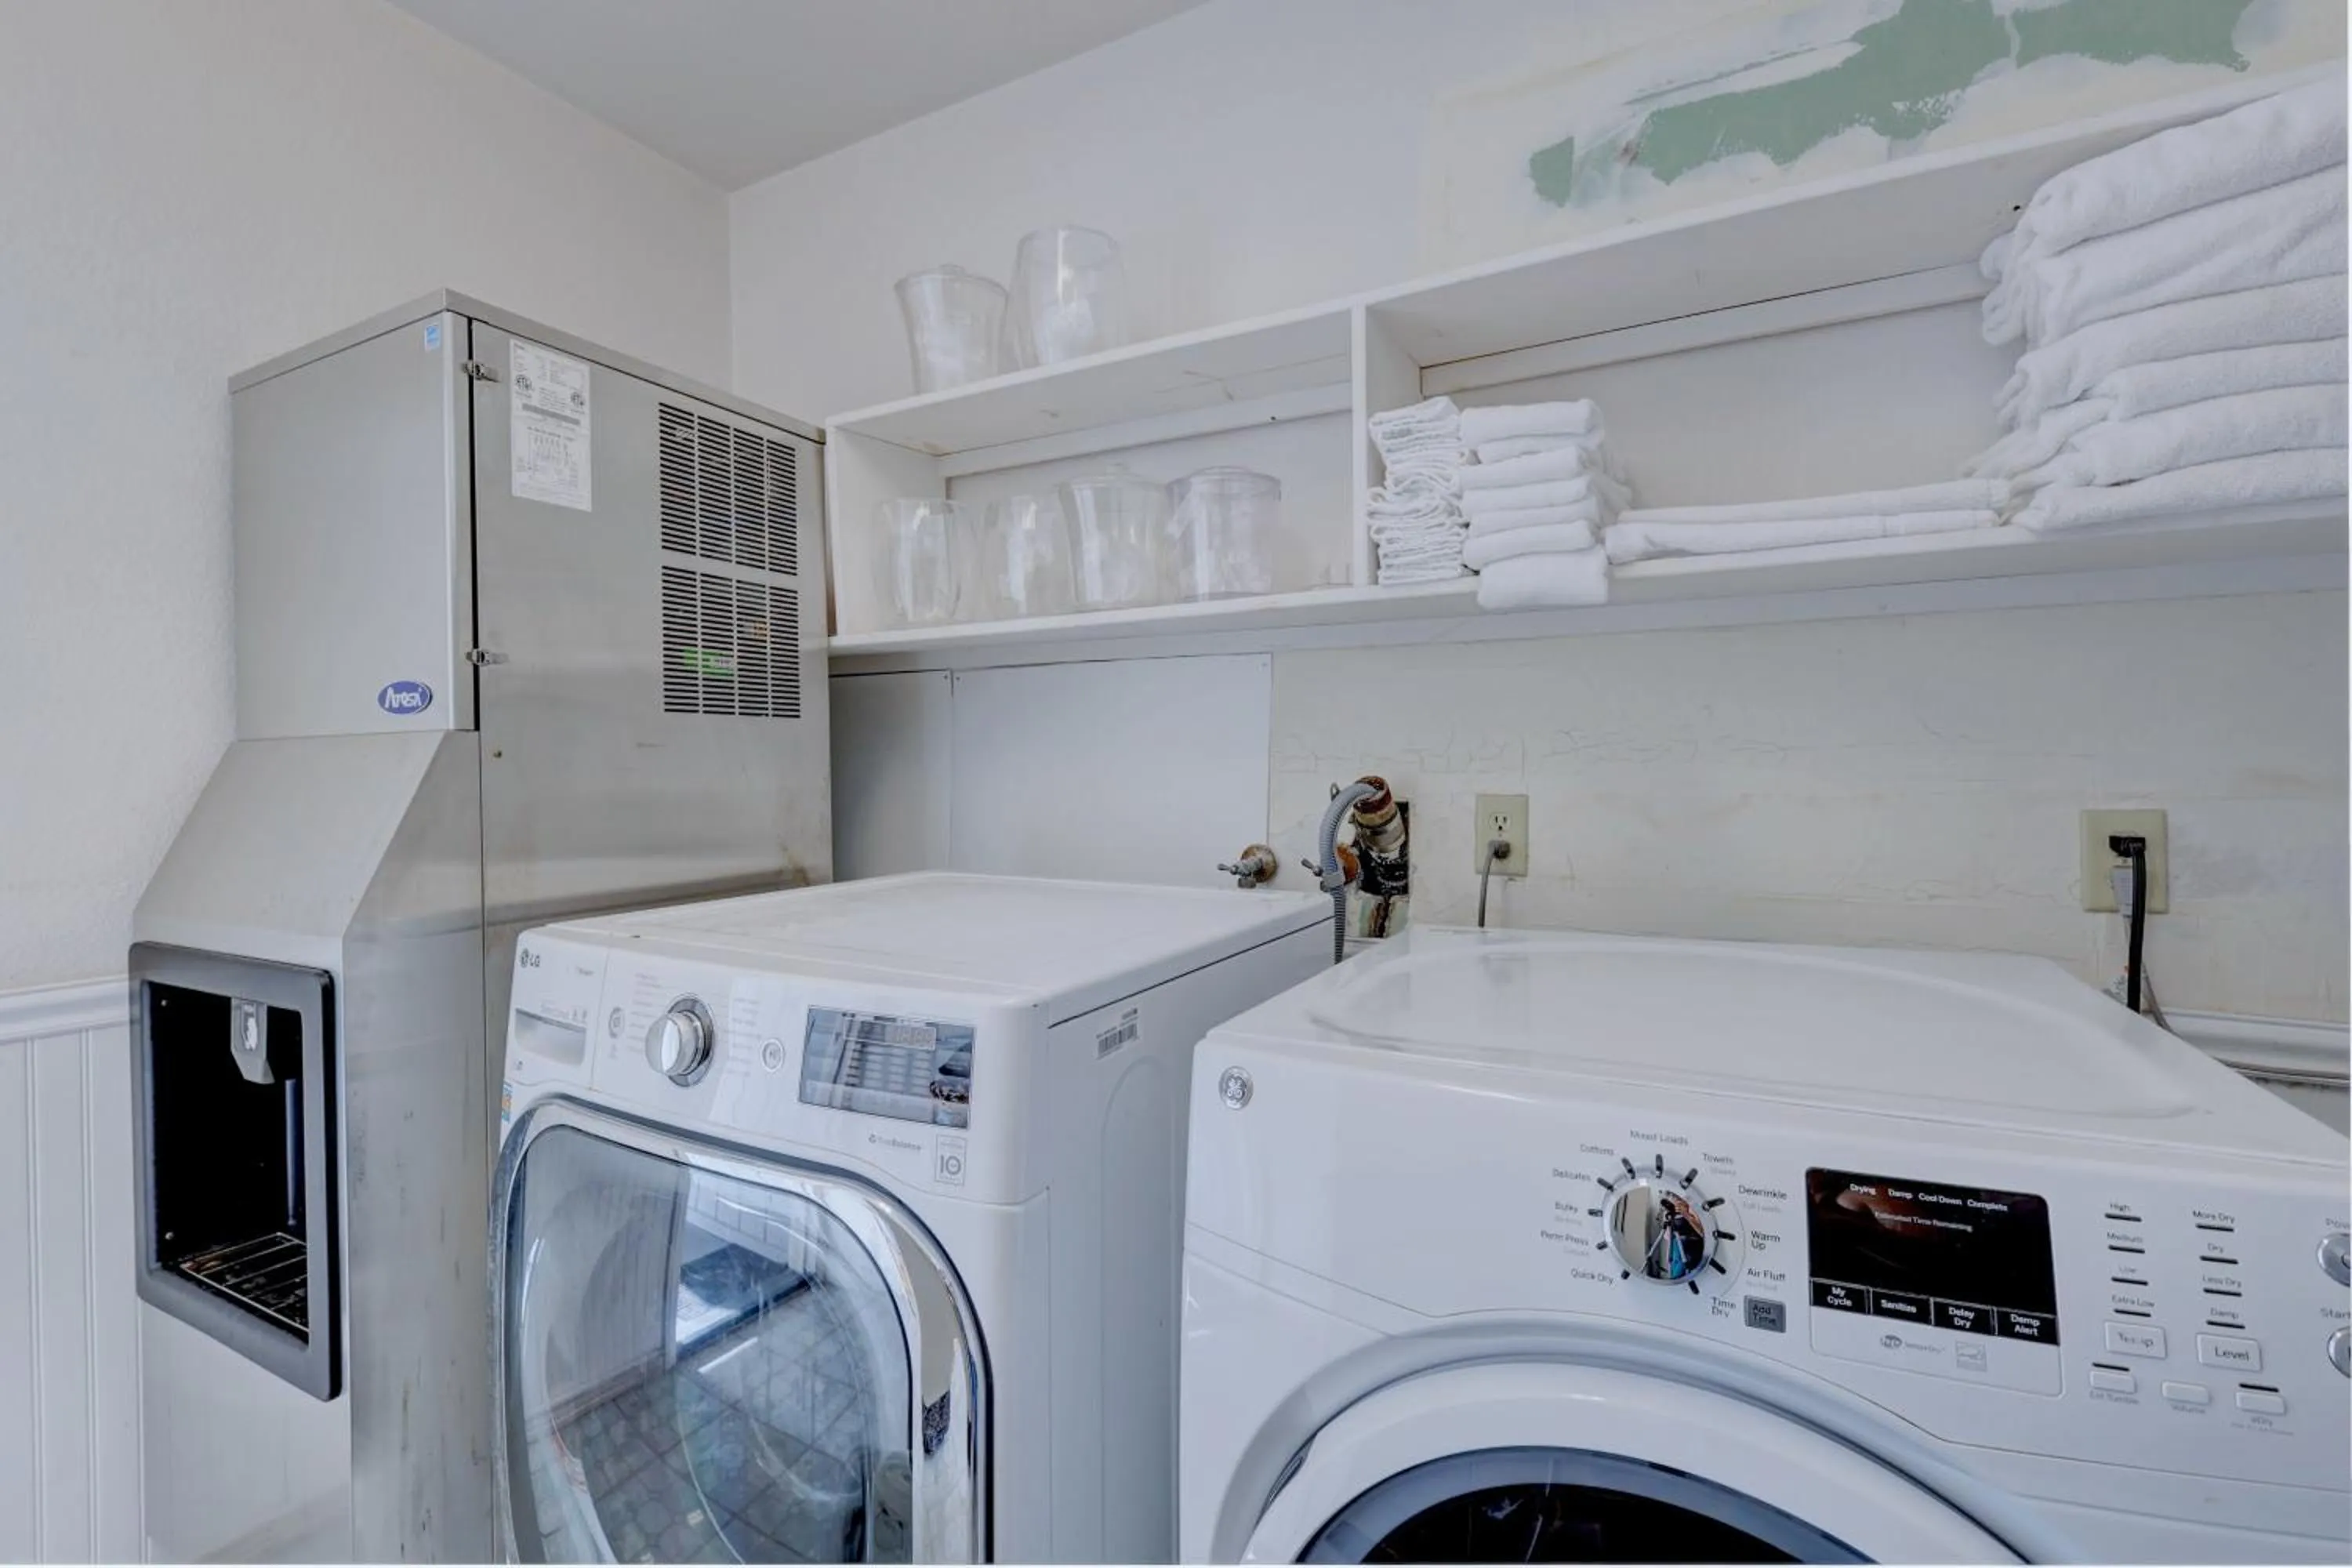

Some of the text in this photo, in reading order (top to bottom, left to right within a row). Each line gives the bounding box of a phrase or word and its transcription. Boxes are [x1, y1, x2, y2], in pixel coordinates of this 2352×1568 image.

[1703, 1152, 1734, 1164] Towels
[1738, 1185, 1788, 1200] Dewrinkle
[1849, 1183, 1877, 1196] Drying
[1888, 1189, 1913, 1200] Damp
[1939, 1196, 1962, 1206] Down
[1967, 1199, 2009, 1211] Complete
[2193, 1210, 2235, 1224] More Dry
[1751, 1230, 1780, 1243] Warm
[1751, 1240, 1766, 1251] Up
[1747, 1268, 1786, 1280] Air Fluff
[1831, 1287, 1846, 1298] My
[1827, 1294, 1853, 1307] Cycle
[1881, 1299, 1918, 1314] Sanitize
[2136, 1298, 2155, 1308] Low
[1949, 1306, 1975, 1319] Delay
[1953, 1316, 1972, 1329] Dry
[2010, 1313, 2040, 1327] Damp
[2014, 1323, 2039, 1337] Alert
[2215, 1345, 2249, 1362] Level
